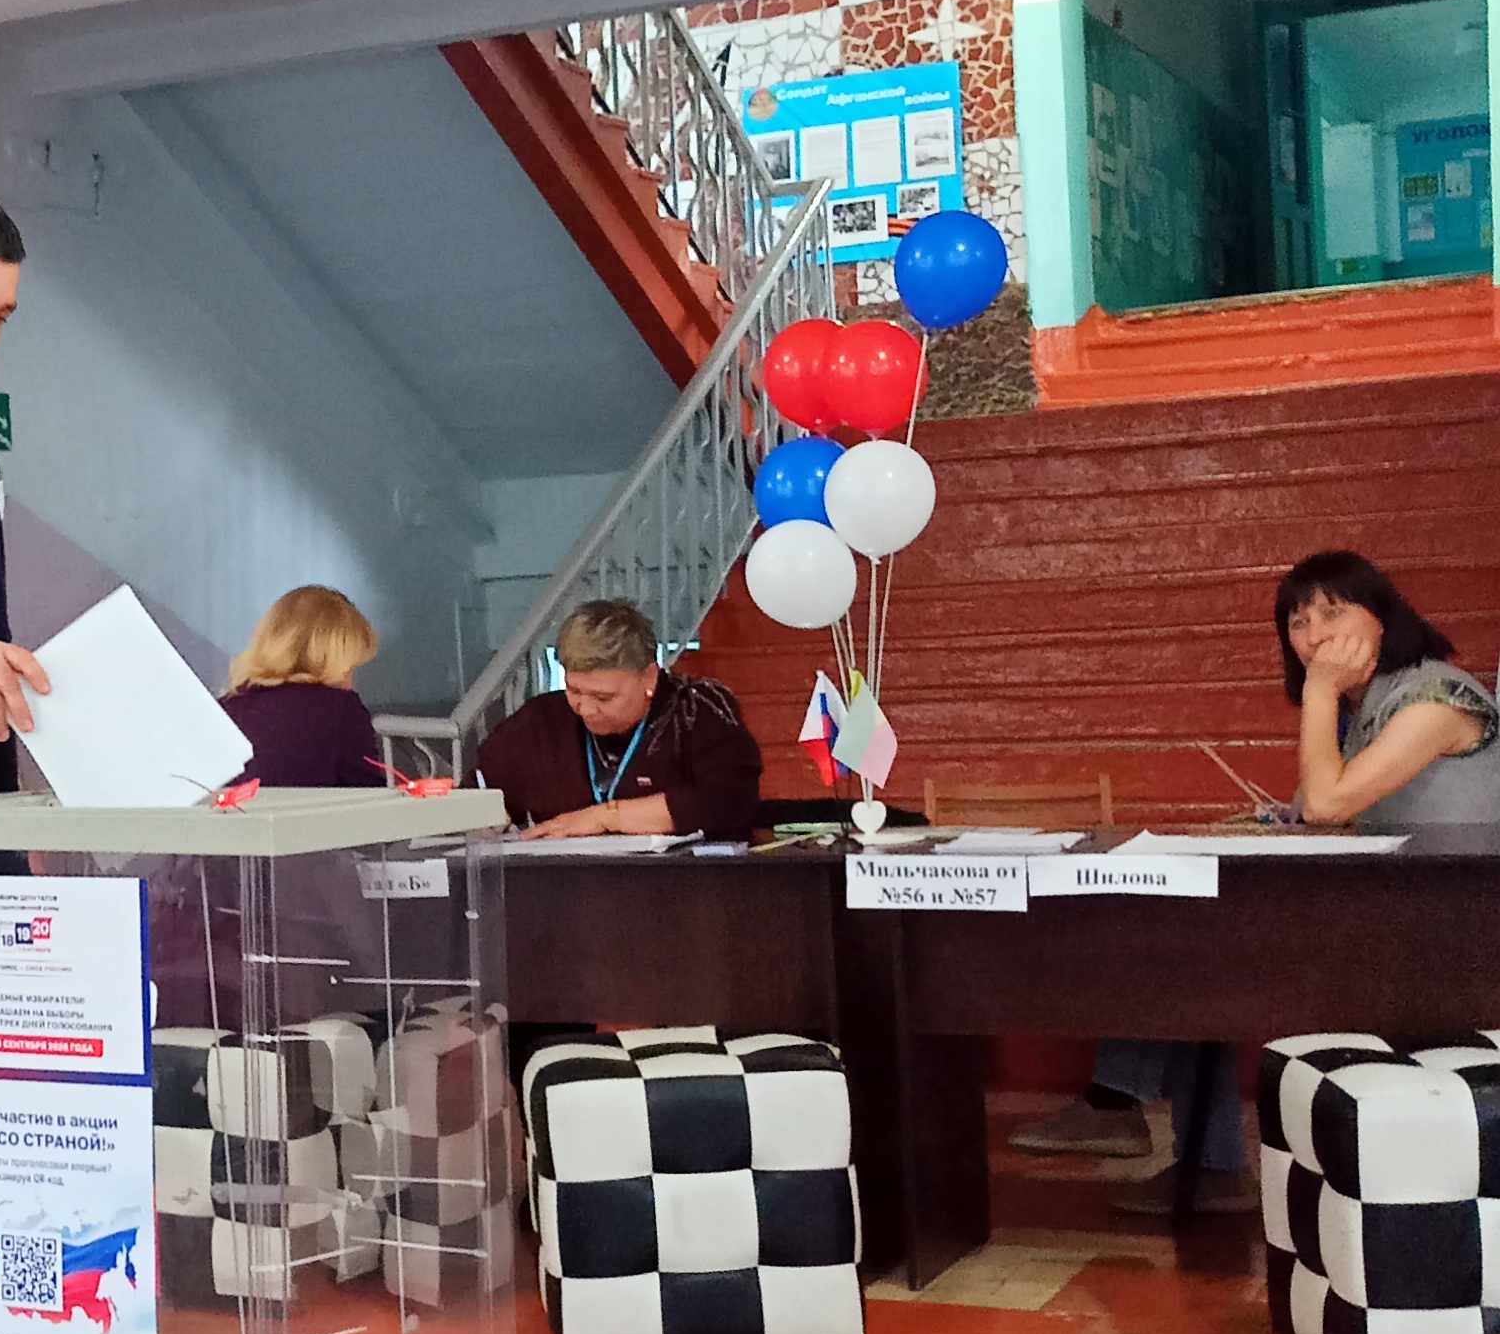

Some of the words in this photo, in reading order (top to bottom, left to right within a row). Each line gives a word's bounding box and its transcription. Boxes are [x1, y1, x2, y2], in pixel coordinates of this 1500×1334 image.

[855, 860, 989, 881] Мильчакова
[996, 865, 1018, 880] от
[1076, 868, 1168, 887] Шилова
[877, 886, 925, 905] №56
[931, 891, 944, 905] и
[949, 888, 998, 906] №57
[1, 934, 14, 947] 18
[16, 926, 31, 942] 19
[32, 920, 50, 936] 20
[32, 1009, 44, 1018] НА
[46, 1010, 84, 1019] ВЫБОРЫ
[22, 1020, 46, 1030] ДНЕЙ
[47, 1021, 113, 1032] ГОЛОСОВАНИЯ
[3, 1039, 48, 1051] СЕНТЯБРЯ
[70, 1042, 94, 1054] ГОДА
[57, 1115, 66, 1126] в
[69, 1116, 118, 1130] акции
[23, 1132, 116, 1152] СТРАНОЙ!»
